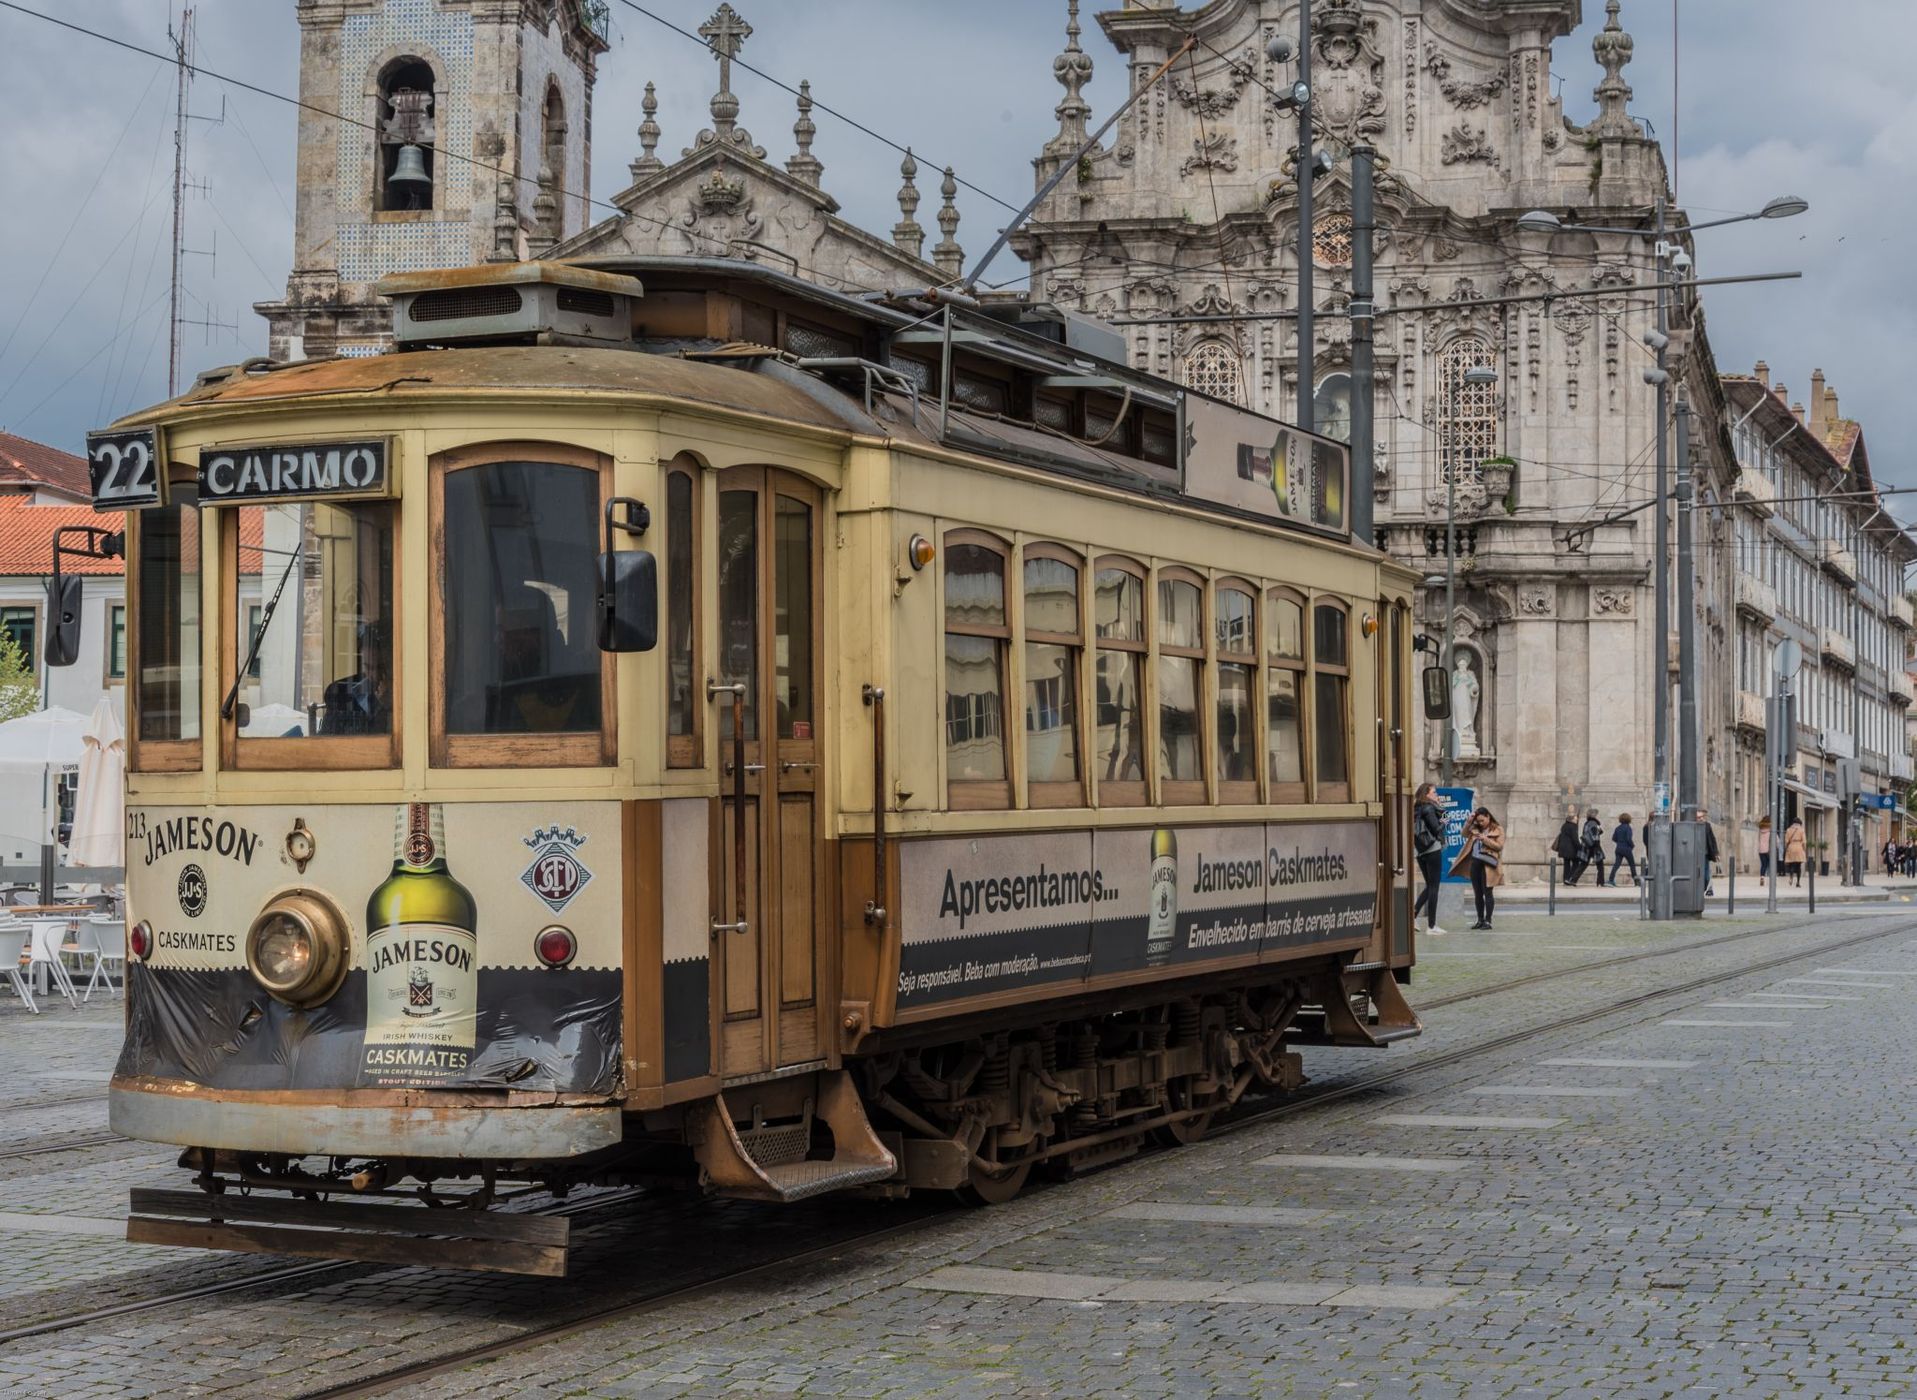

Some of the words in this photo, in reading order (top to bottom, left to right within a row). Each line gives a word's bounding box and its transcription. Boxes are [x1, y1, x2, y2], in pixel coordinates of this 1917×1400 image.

[95, 440, 150, 498] 22
[207, 448, 377, 495] CARMO
[1289, 437, 1298, 514] JAMESON
[62, 763, 79, 771] SUPER
[128, 812, 146, 839] 213
[145, 816, 258, 867] JAMESON
[1193, 852, 1263, 893] Jameson
[1268, 846, 1348, 887] Caskmates.
[939, 863, 1119, 930] Apresentamos...
[158, 931, 236, 952] CASKMATES
[1188, 917, 1248, 949] Envelhecido
[1249, 921, 1265, 940] em
[1265, 911, 1291, 937] barris
[1292, 911, 1304, 933] de
[1305, 906, 1336, 935] cerveja
[1337, 902, 1375, 929] artesanal
[372, 939, 472, 974] JAMESON
[898, 970, 917, 996] Seja
[916, 962, 963, 992] responsável.
[964, 961, 984, 982] Beba
[984, 962, 1000, 978] com
[1000, 953, 1039, 976] moderação.
[366, 1049, 467, 1069] CASKMATES
[408, 1032, 454, 1041] WHISKEY
